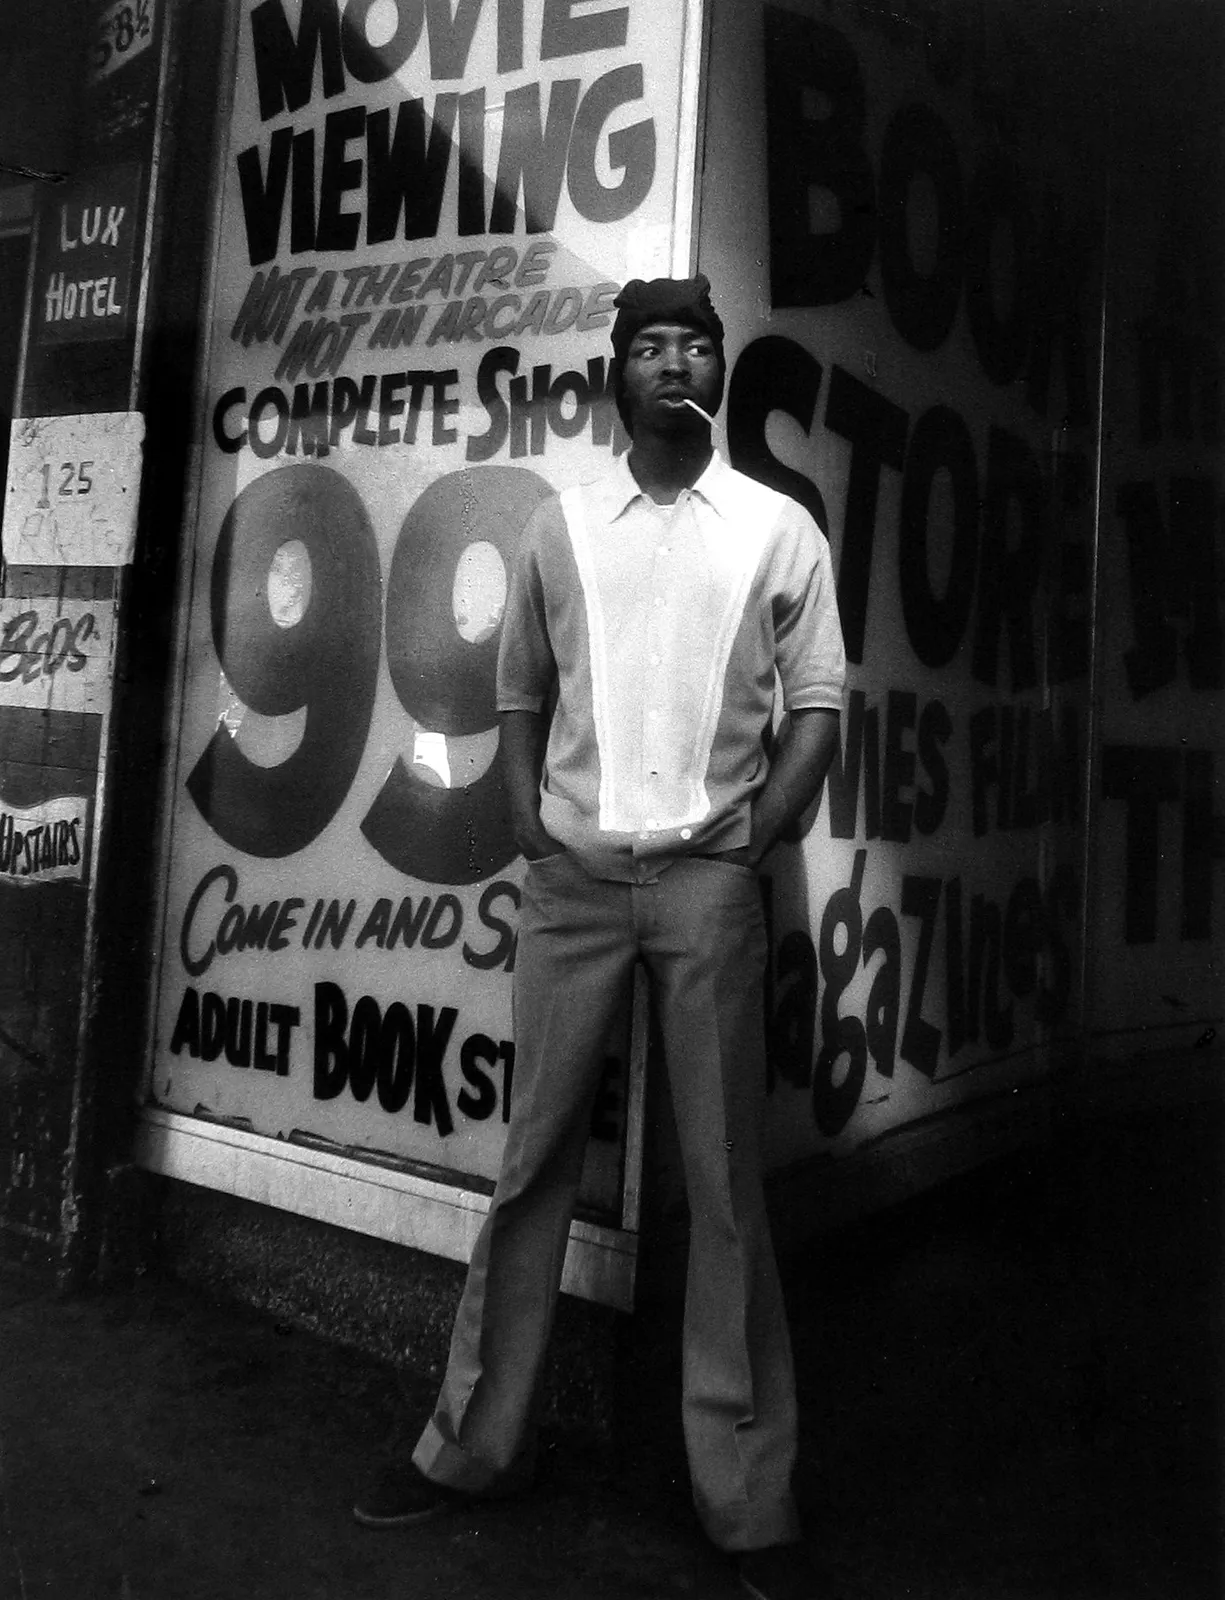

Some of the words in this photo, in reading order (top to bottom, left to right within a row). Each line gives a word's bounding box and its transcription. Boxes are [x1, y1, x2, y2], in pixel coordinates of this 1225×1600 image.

[237, 62, 656, 266] VIEWING
[763, 4, 1092, 430] BOOK
[60, 204, 126, 251] LUX
[45, 272, 122, 322] HOTEL
[231, 266, 316, 347] NOT
[305, 271, 340, 313] A
[339, 241, 557, 309] THEATRE
[274, 313, 371, 381] NOT
[369, 303, 423, 349] AN
[426, 282, 621, 347] ARCADE
[213, 369, 459, 459] COMPLETE
[466, 346, 633, 461] SHOW
[727, 335, 1089, 695] STORE
[186, 463, 561, 886] 99
[0, 813, 80, 876] UPSTAIRS
[181, 864, 304, 976] COME
[302, 898, 356, 949] IN
[355, 894, 464, 949] AND
[170, 986, 300, 1076] ADULT
[314, 982, 458, 1137] BOOK
